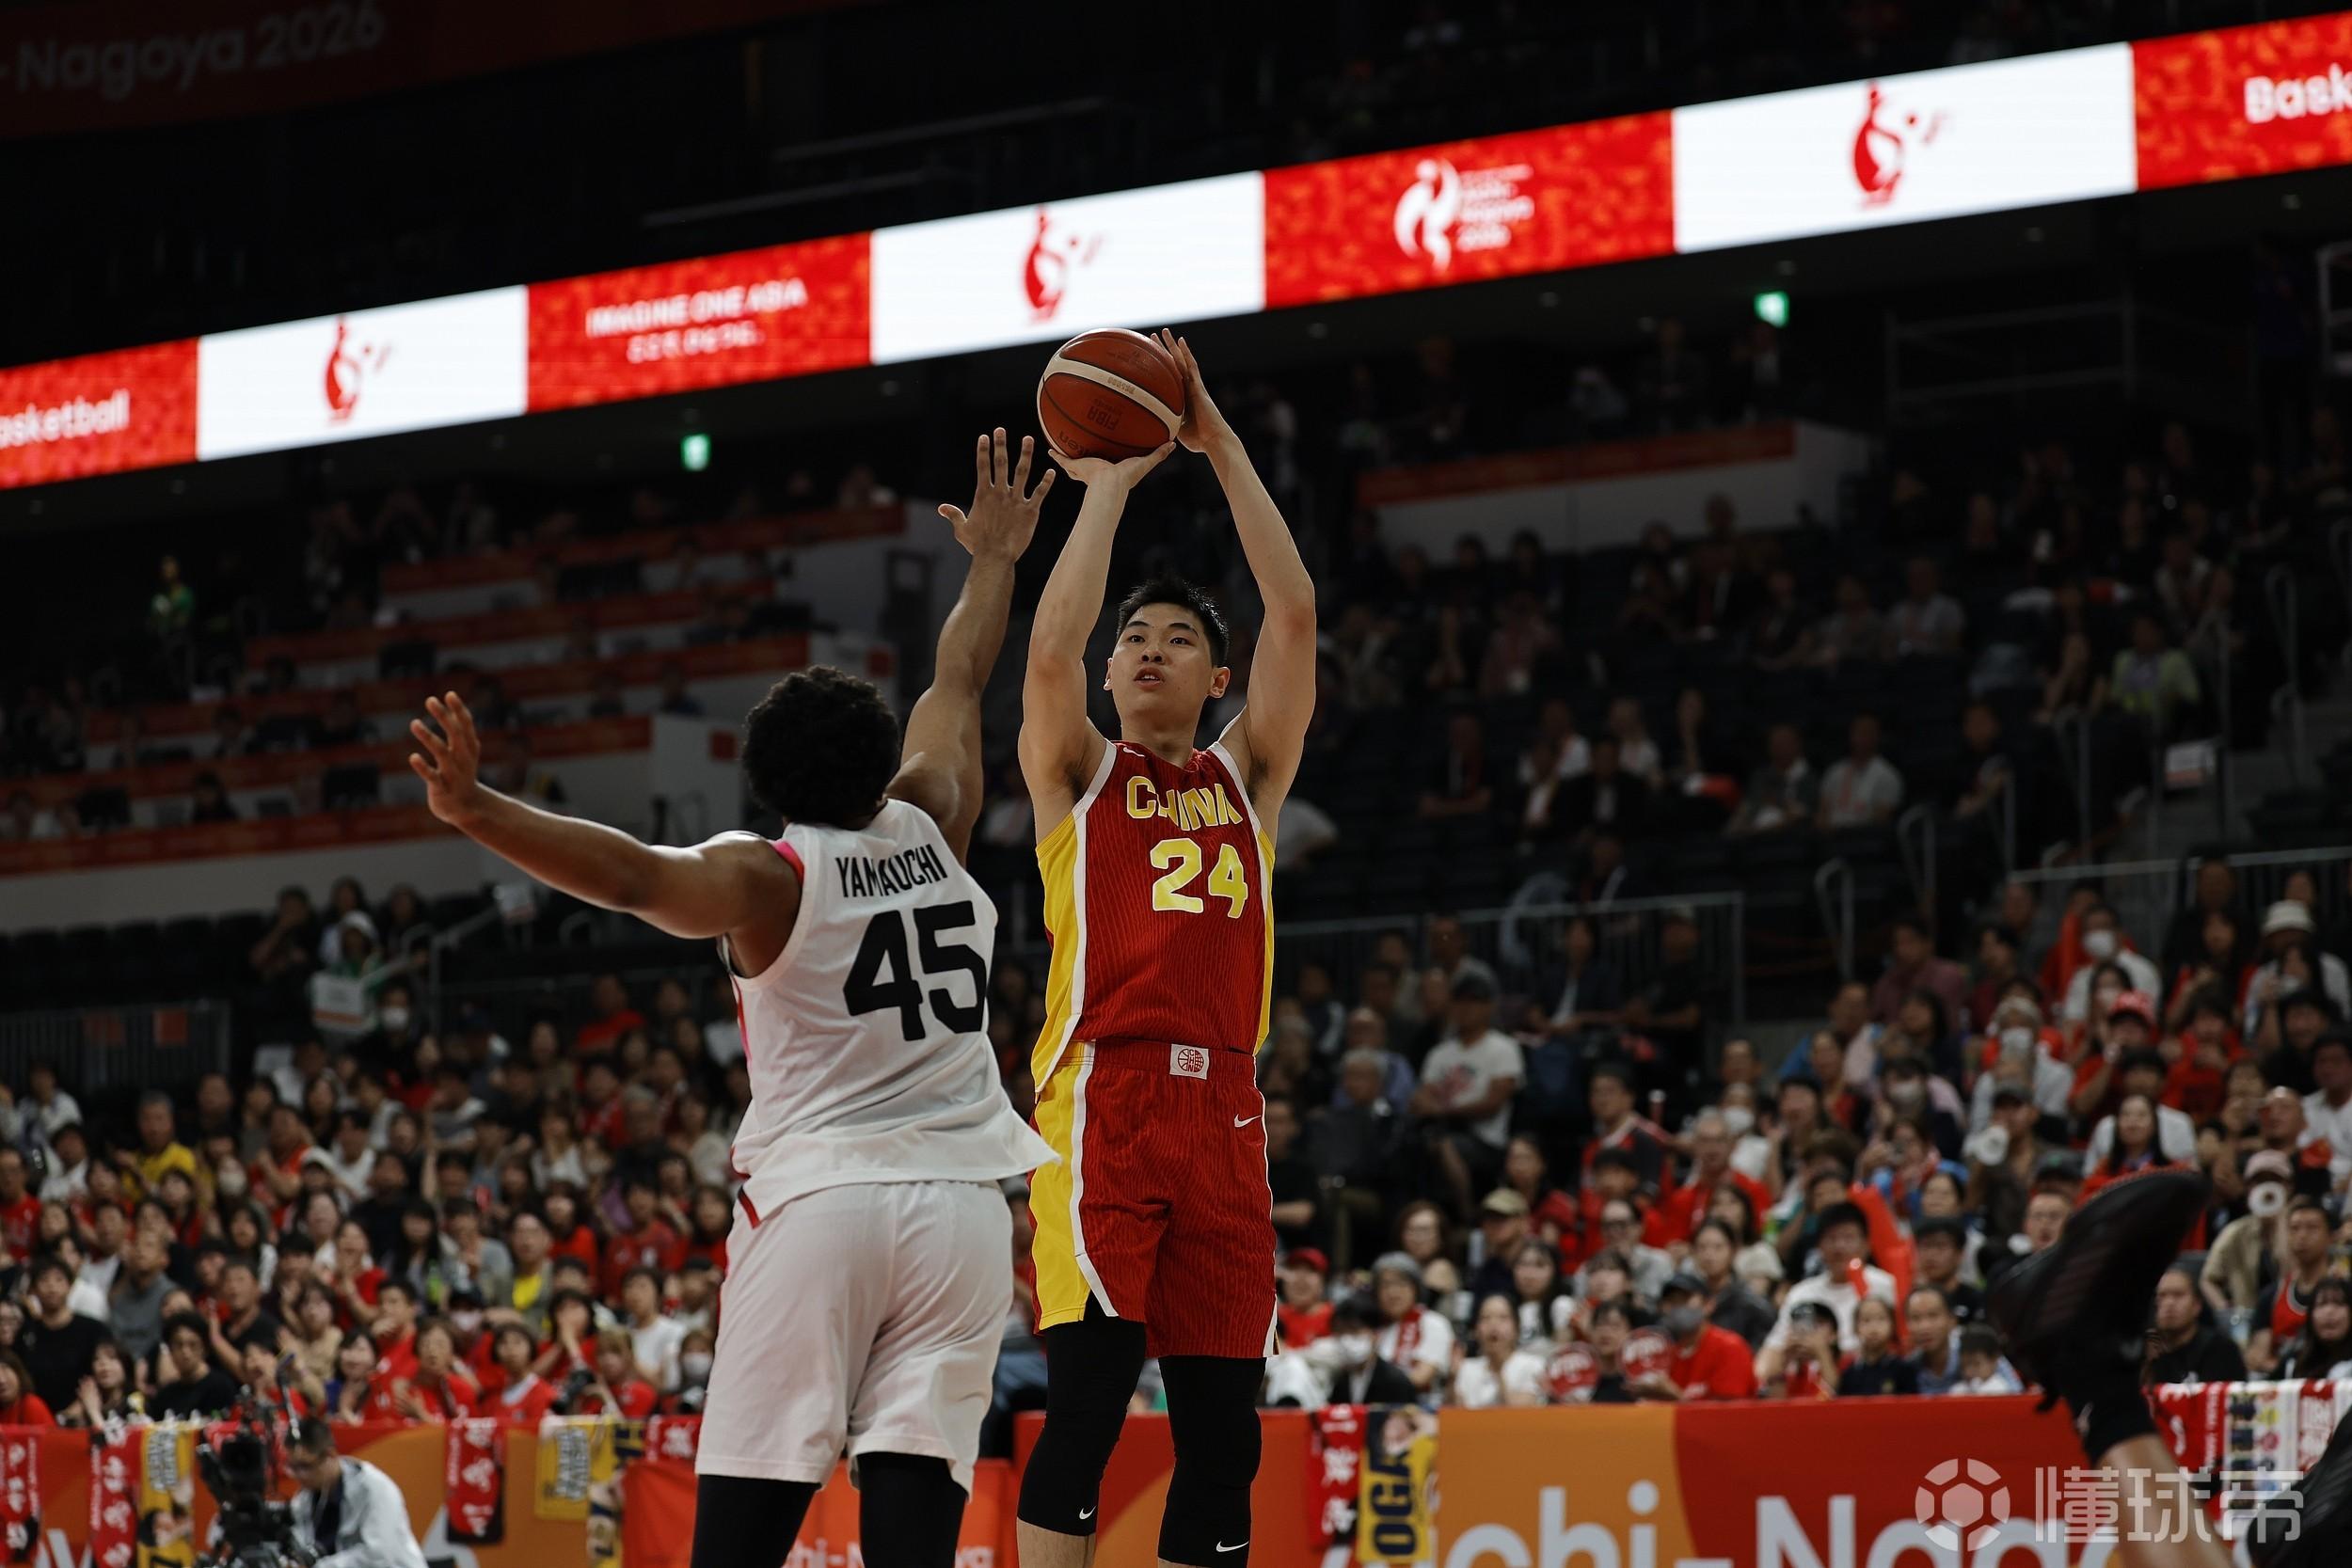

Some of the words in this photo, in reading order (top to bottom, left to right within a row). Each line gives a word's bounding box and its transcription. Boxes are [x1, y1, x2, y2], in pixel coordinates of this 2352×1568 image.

[255, 0, 387, 70] 2026
[2244, 61, 2352, 124] Bask
[1126, 775, 1244, 832] CHINA
[835, 843, 948, 898] YAMAUCHI
[1149, 836, 1248, 919] 24
[843, 899, 988, 1041] 45
